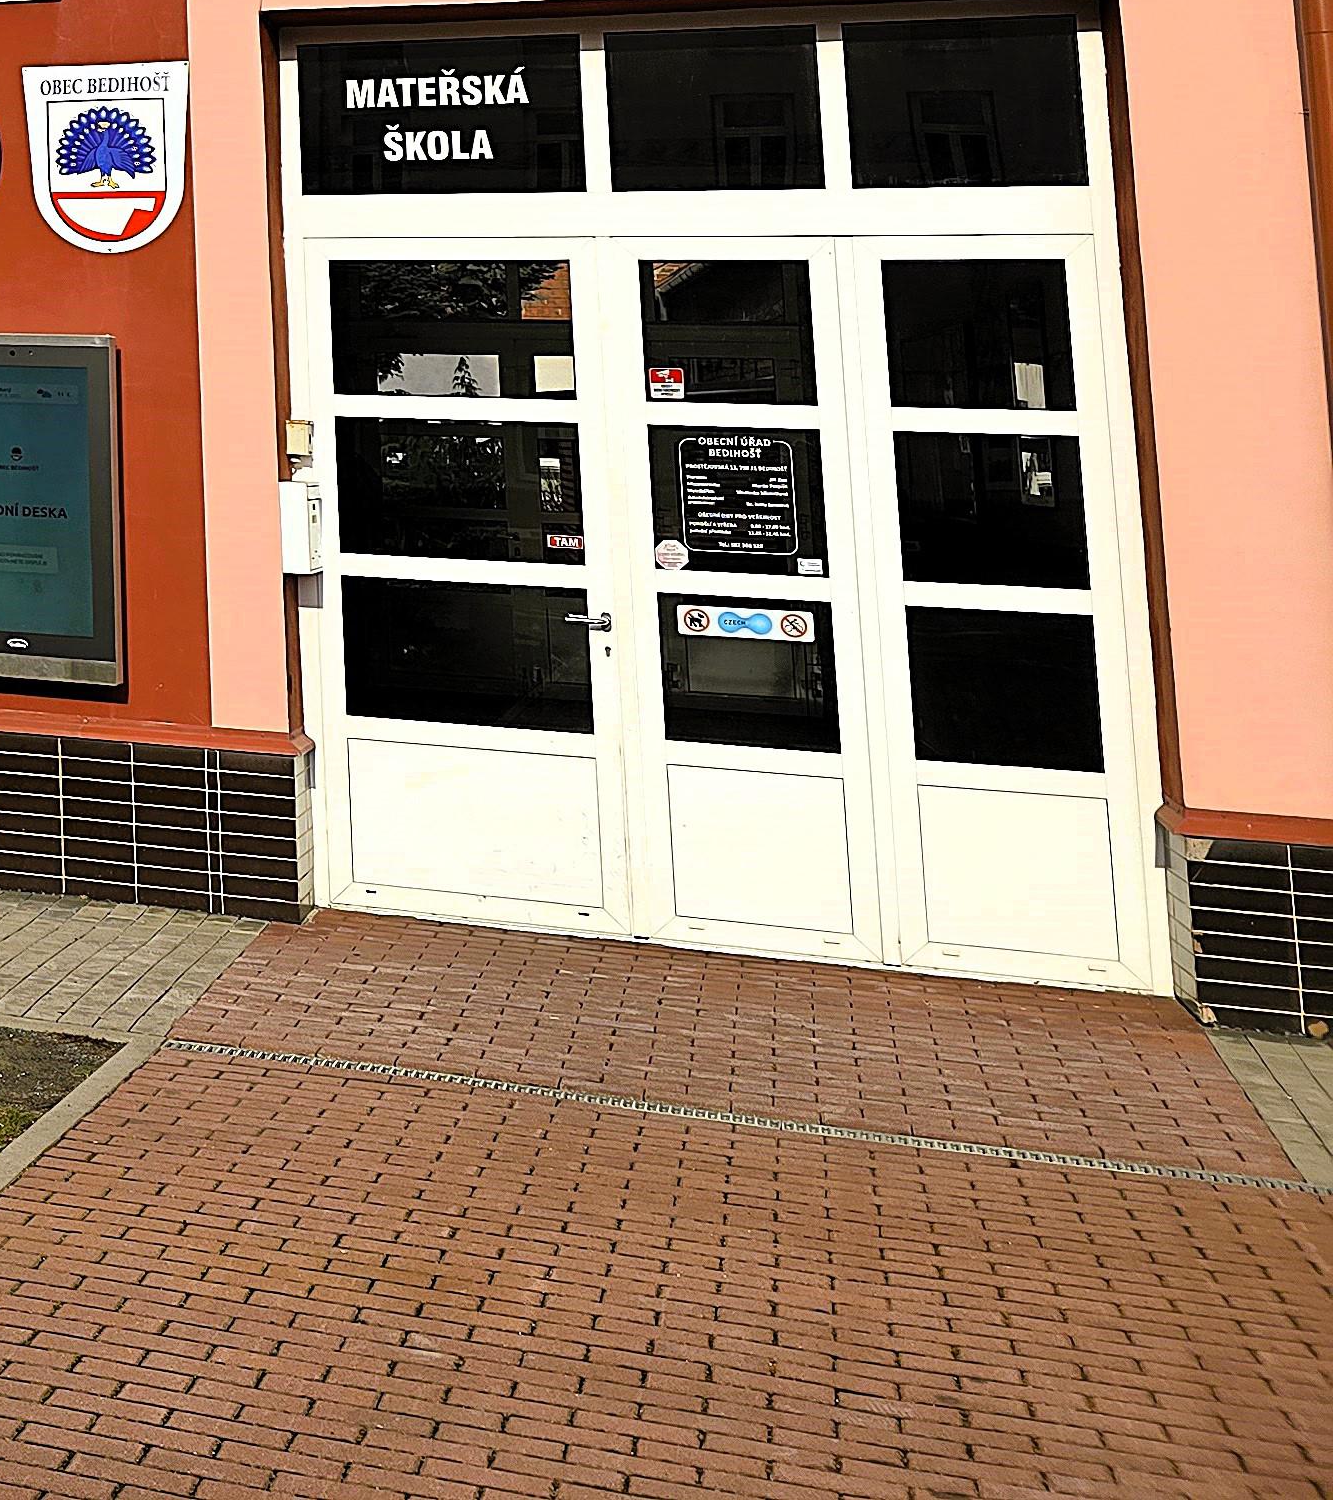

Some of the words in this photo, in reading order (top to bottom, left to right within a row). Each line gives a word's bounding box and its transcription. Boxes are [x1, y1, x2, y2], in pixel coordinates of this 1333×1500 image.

[40, 78, 83, 96] OBEC
[86, 71, 171, 94] BEDIHOŠŤ
[346, 66, 529, 109] MATEŘSKÁ
[383, 124, 494, 162] ŠKOLA
[698, 436, 738, 446] OBECNÍ
[740, 436, 771, 447] ÚŘAD
[709, 448, 762, 458] BEDIHOŠŤ
[22, 506, 68, 519] DESKA
[554, 537, 579, 548] TAM
